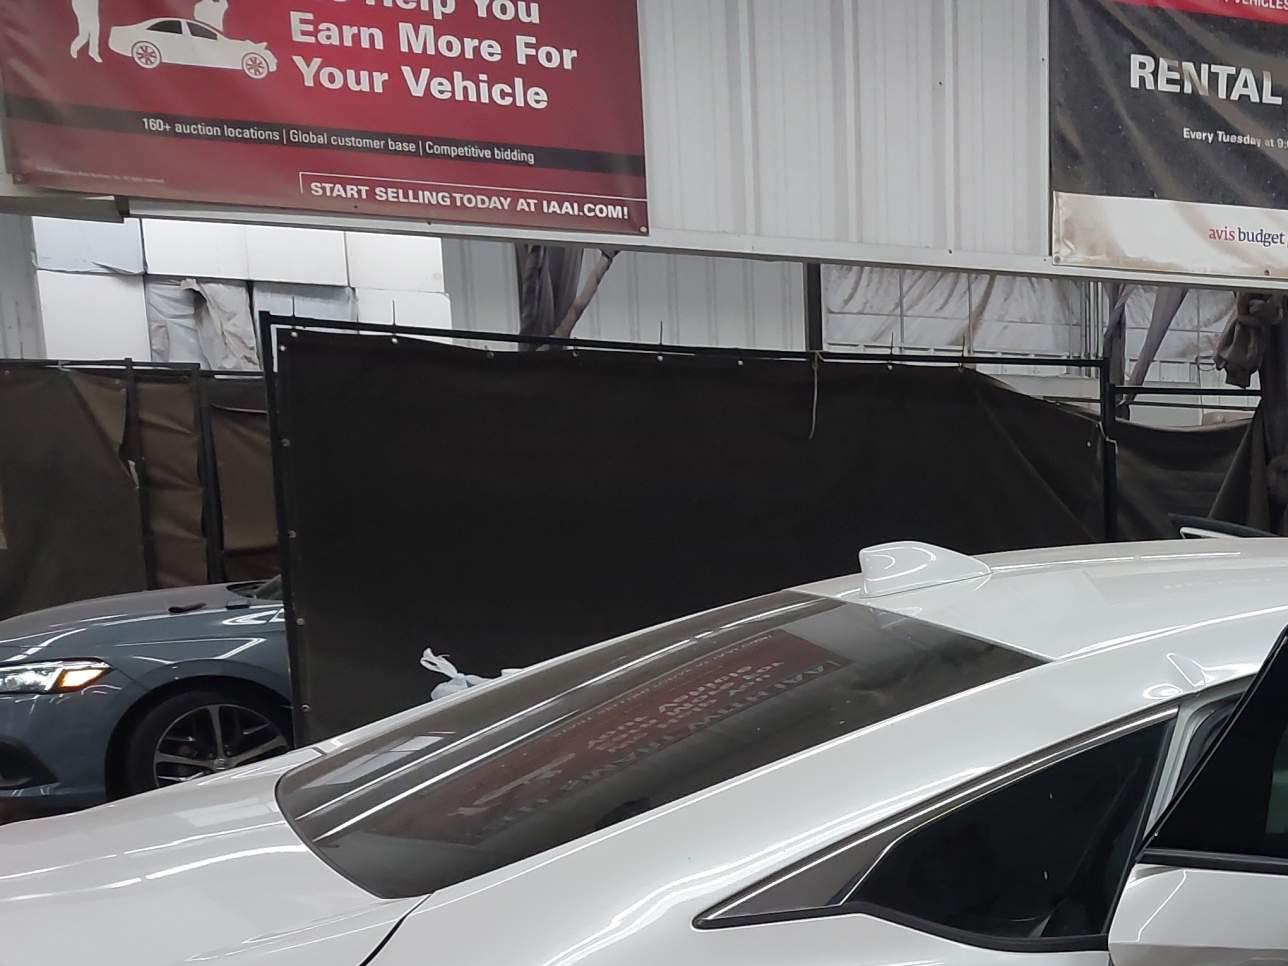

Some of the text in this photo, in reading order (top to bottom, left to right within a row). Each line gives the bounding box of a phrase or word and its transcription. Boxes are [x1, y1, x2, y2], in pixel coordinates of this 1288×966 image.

[290, 11, 578, 70] Earn More For
[292, 55, 548, 109] Your Vehicle
[1130, 53, 1282, 105] RENTAL
[142, 117, 171, 132] 160+
[175, 122, 221, 136] auction
[224, 124, 280, 141] locations
[289, 129, 328, 145] Global
[330, 135, 385, 149] customer
[388, 138, 416, 152] base
[425, 141, 492, 159] Competitive
[494, 147, 535, 165] bidding
[1183, 127, 1214, 143] Every
[1217, 130, 1262, 148] Tuesday
[1264, 138, 1275, 147] at
[310, 182, 628, 219] START SELLING TODAY AT IAAI.COM!
[1208, 226, 1236, 241] avis
[1238, 227, 1286, 247] budget
